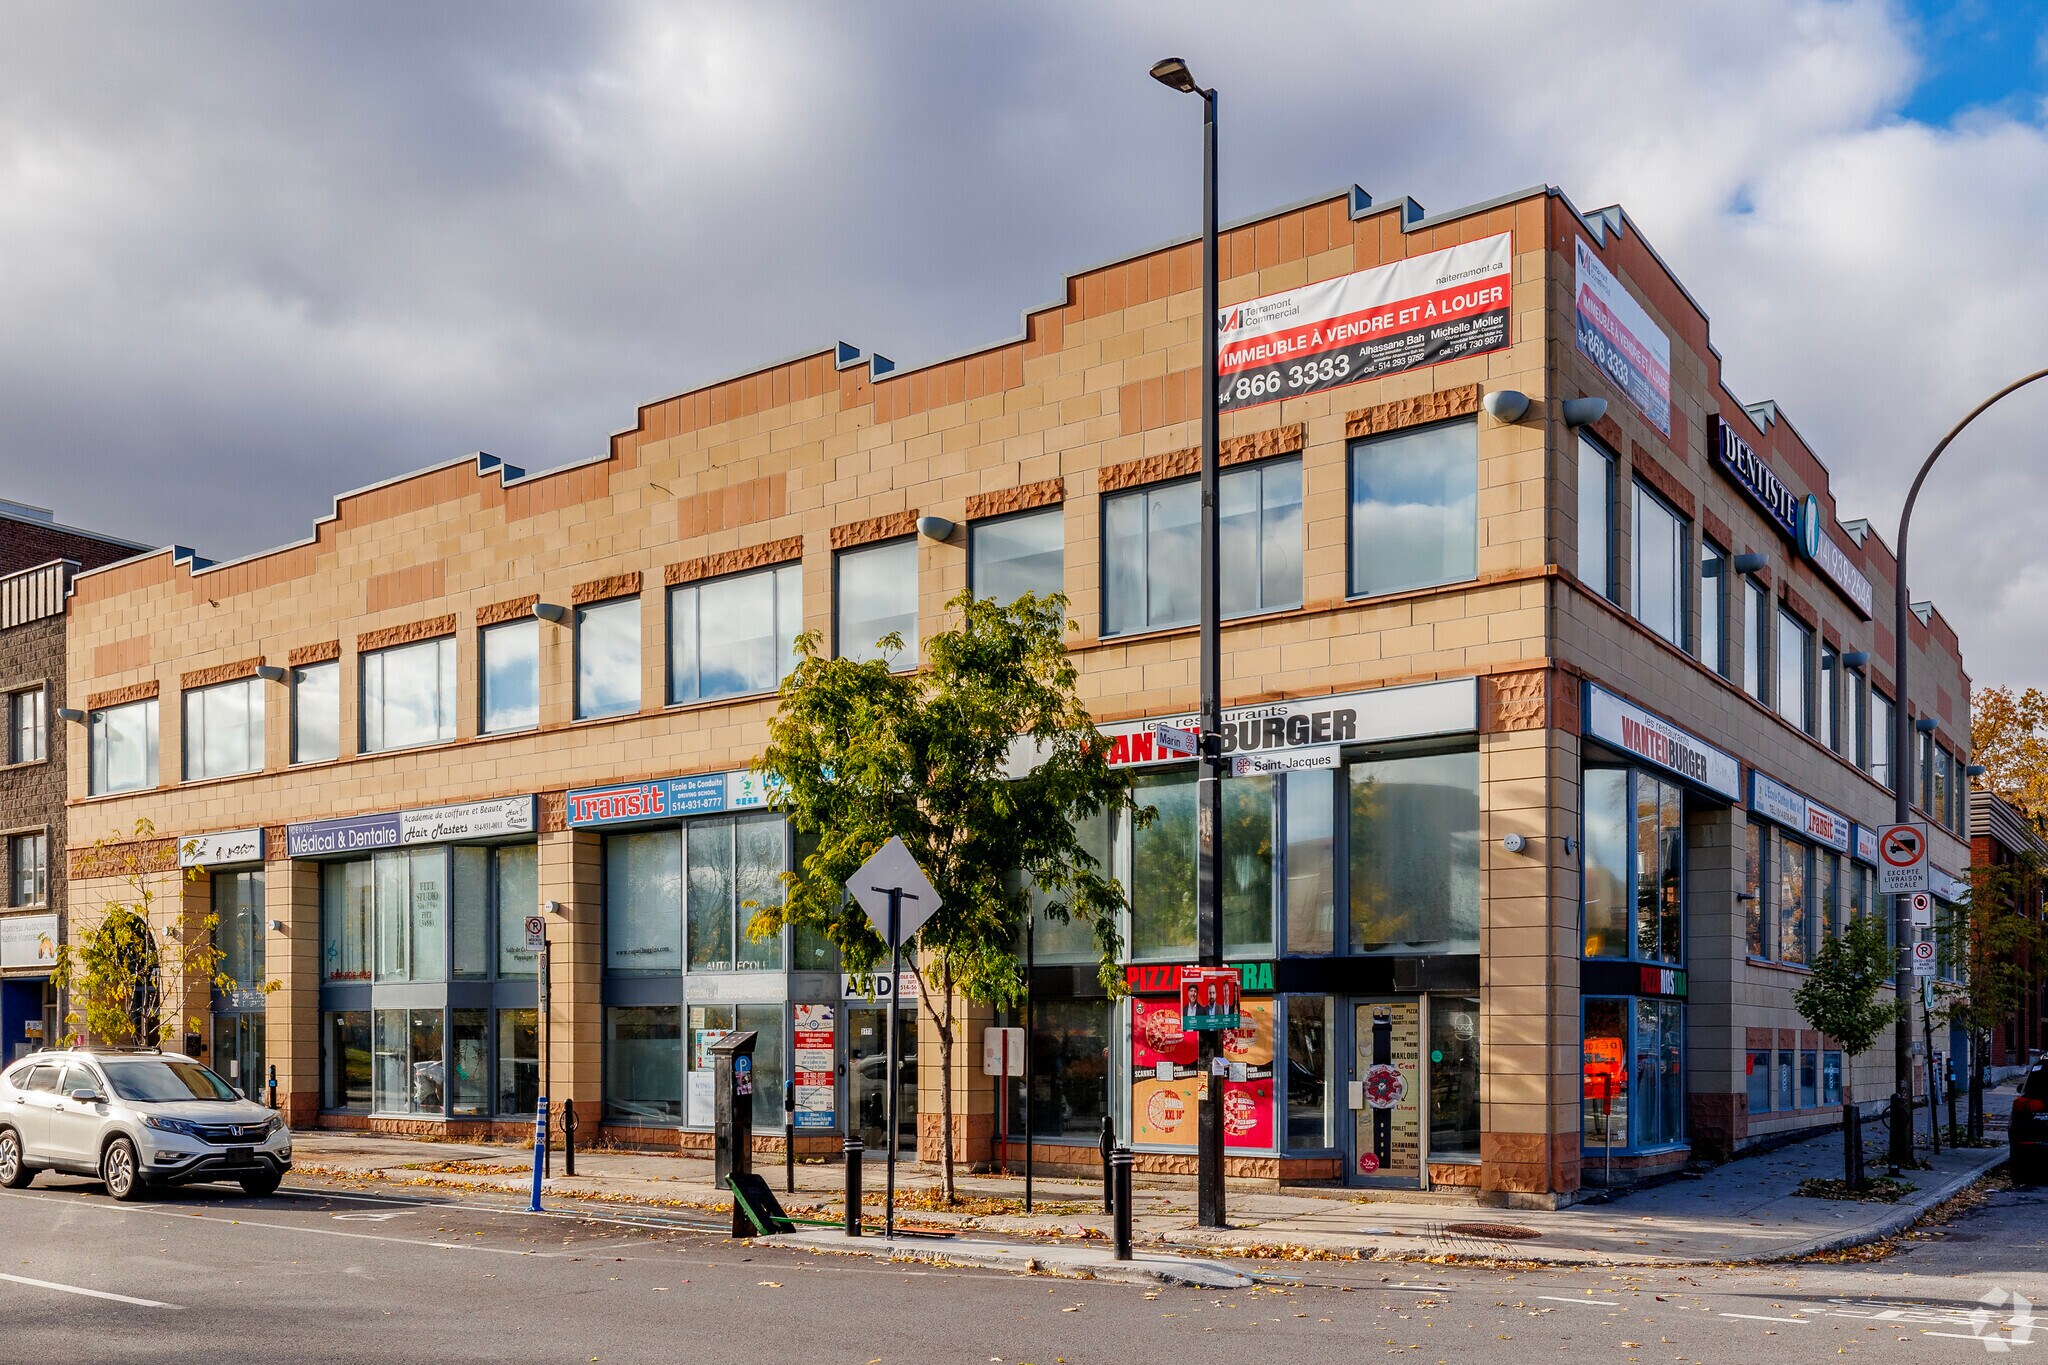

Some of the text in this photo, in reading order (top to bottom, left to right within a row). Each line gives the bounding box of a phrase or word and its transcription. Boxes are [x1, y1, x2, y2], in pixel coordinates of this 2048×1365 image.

[1435, 261, 1504, 285] naiterramont.ca
[1245, 298, 1291, 317] Terramont
[1245, 305, 1300, 327] Commercial
[1223, 286, 1503, 368] IMMEUBLE À VENDRE ET À LOUER
[1431, 315, 1504, 339] Michelle Moller
[1358, 334, 1425, 357] Alhassane Bah
[1454, 342, 1467, 353] 514
[1469, 338, 1483, 348] 730
[1485, 335, 1504, 346] 9877
[1583, 292, 1615, 337] IMMEUBLE
[1619, 330, 1641, 366] VENDRE
[1641, 353, 1649, 370] ET
[1653, 367, 1669, 394] LOUER
[1378, 360, 1391, 371] 514
[1392, 356, 1406, 367] 293
[1407, 353, 1425, 364] 9752
[1578, 329, 1588, 346] 514
[1587, 330, 1606, 364] 866
[1607, 349, 1629, 385] 3333
[1235, 370, 1281, 400] 866
[1288, 354, 1350, 388] 3333
[1726, 427, 1795, 527] DENTISTE
[1831, 549, 1872, 613] 939-2646
[1644, 714, 1690, 747] les restaurants
[1160, 732, 1181, 748] Marin
[1254, 756, 1332, 772] Saint-Jacques
[689, 780, 697, 789] De
[697, 777, 723, 789] Conduite
[677, 789, 717, 799] DRIVING SCHOOL
[569, 785, 665, 824] Transit
[672, 797, 722, 811] 514-931-8777
[435, 810, 443, 819] de
[444, 808, 470, 819] coiffure
[471, 807, 478, 815] et
[505, 808, 519, 819] Hair
[291, 825, 313, 834] CENTRE
[506, 817, 528, 827] Masters
[1808, 807, 1834, 840] Transit
[291, 827, 397, 854] Médical & Dentaire
[404, 826, 428, 842] Hair
[431, 823, 469, 840] Masters
[1884, 874, 1923, 884] LIVRAISON
[1890, 881, 1917, 889] LOCALE
[416, 891, 439, 901] STUDIO
[707, 960, 731, 971] AUTO
[1391, 1052, 1419, 1060] MAKLOUB
[1135, 1069, 1156, 1078] SCANNEZ
[1174, 1070, 1197, 1078] COMMANDER
[1247, 1071, 1272, 1079] COMMANDER
[1391, 1141, 1418, 1149] SHAWARMA
